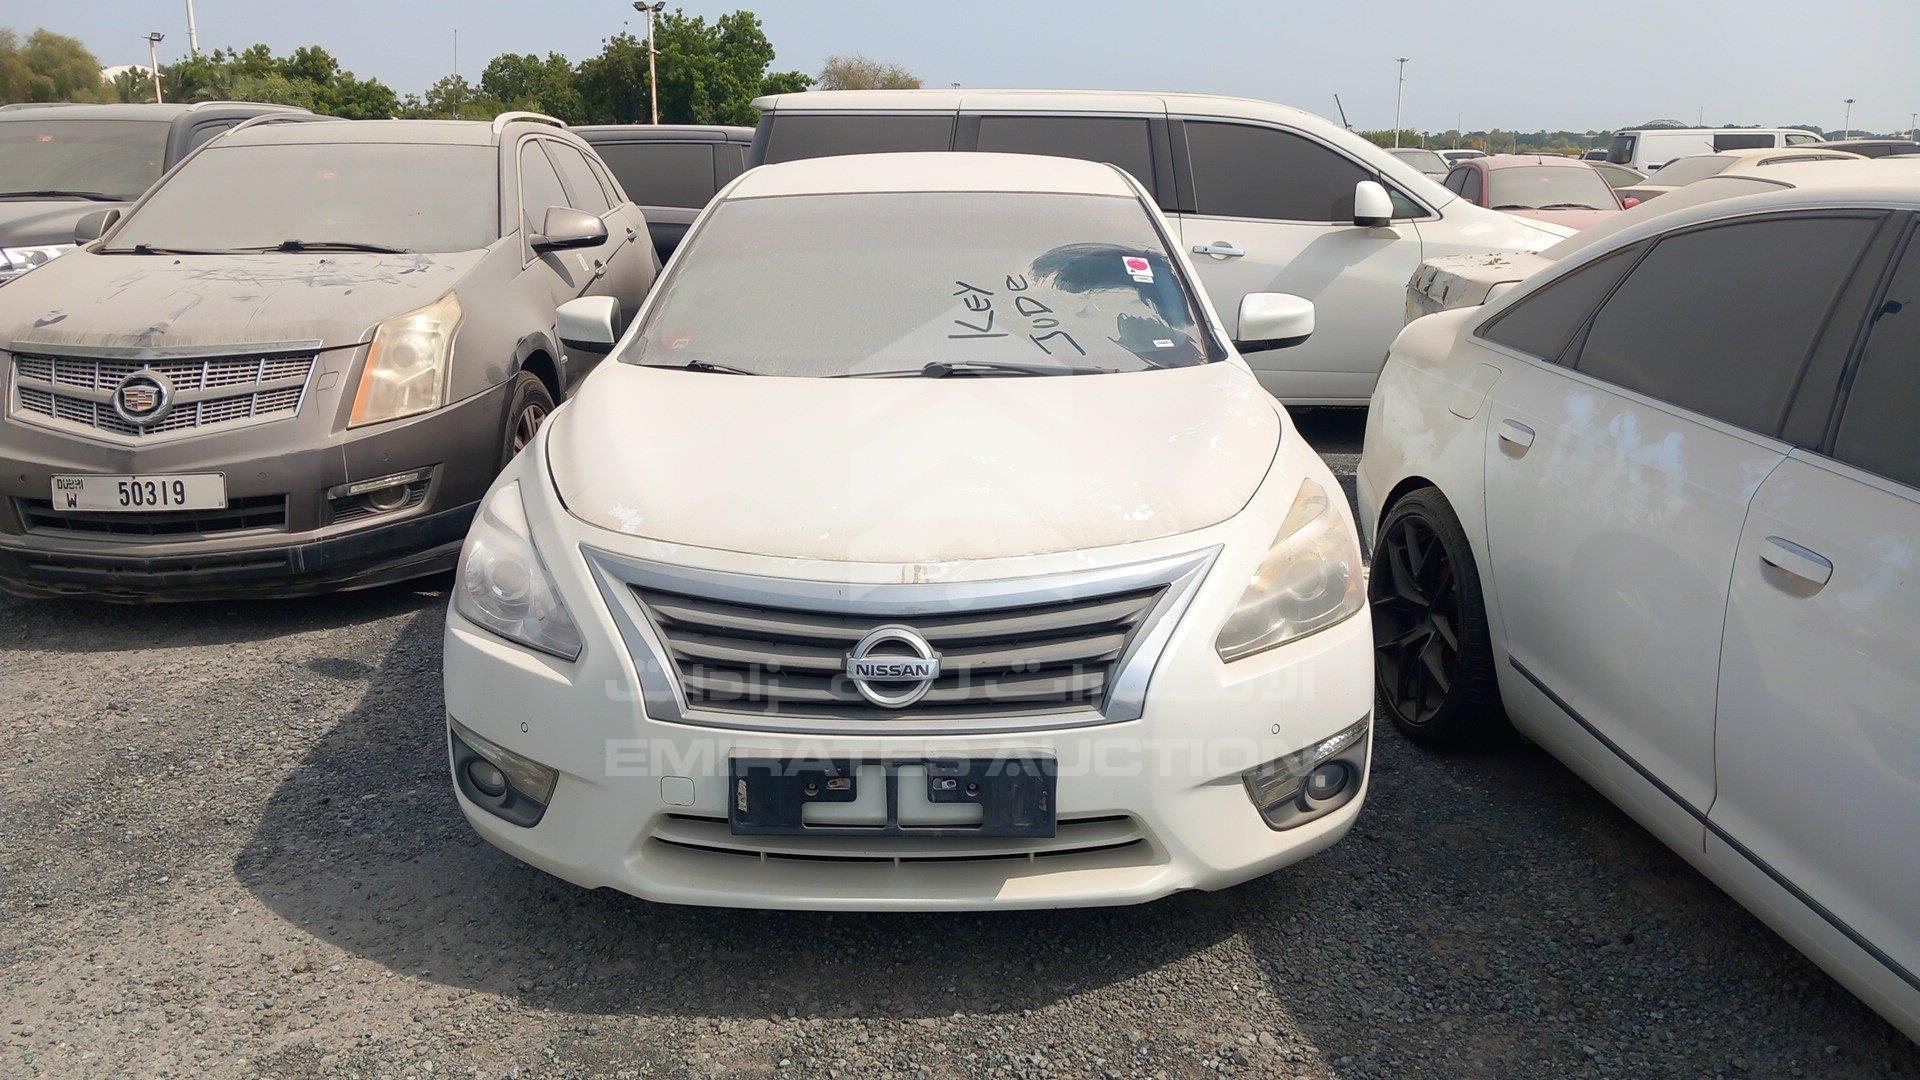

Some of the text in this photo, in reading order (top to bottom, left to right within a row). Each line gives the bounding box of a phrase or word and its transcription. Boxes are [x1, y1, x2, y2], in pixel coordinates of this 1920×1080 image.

[947, 280, 1009, 339] KEY
[66, 492, 78, 508] W
[117, 479, 186, 507] 50319
[856, 664, 930, 677] NISSAN
